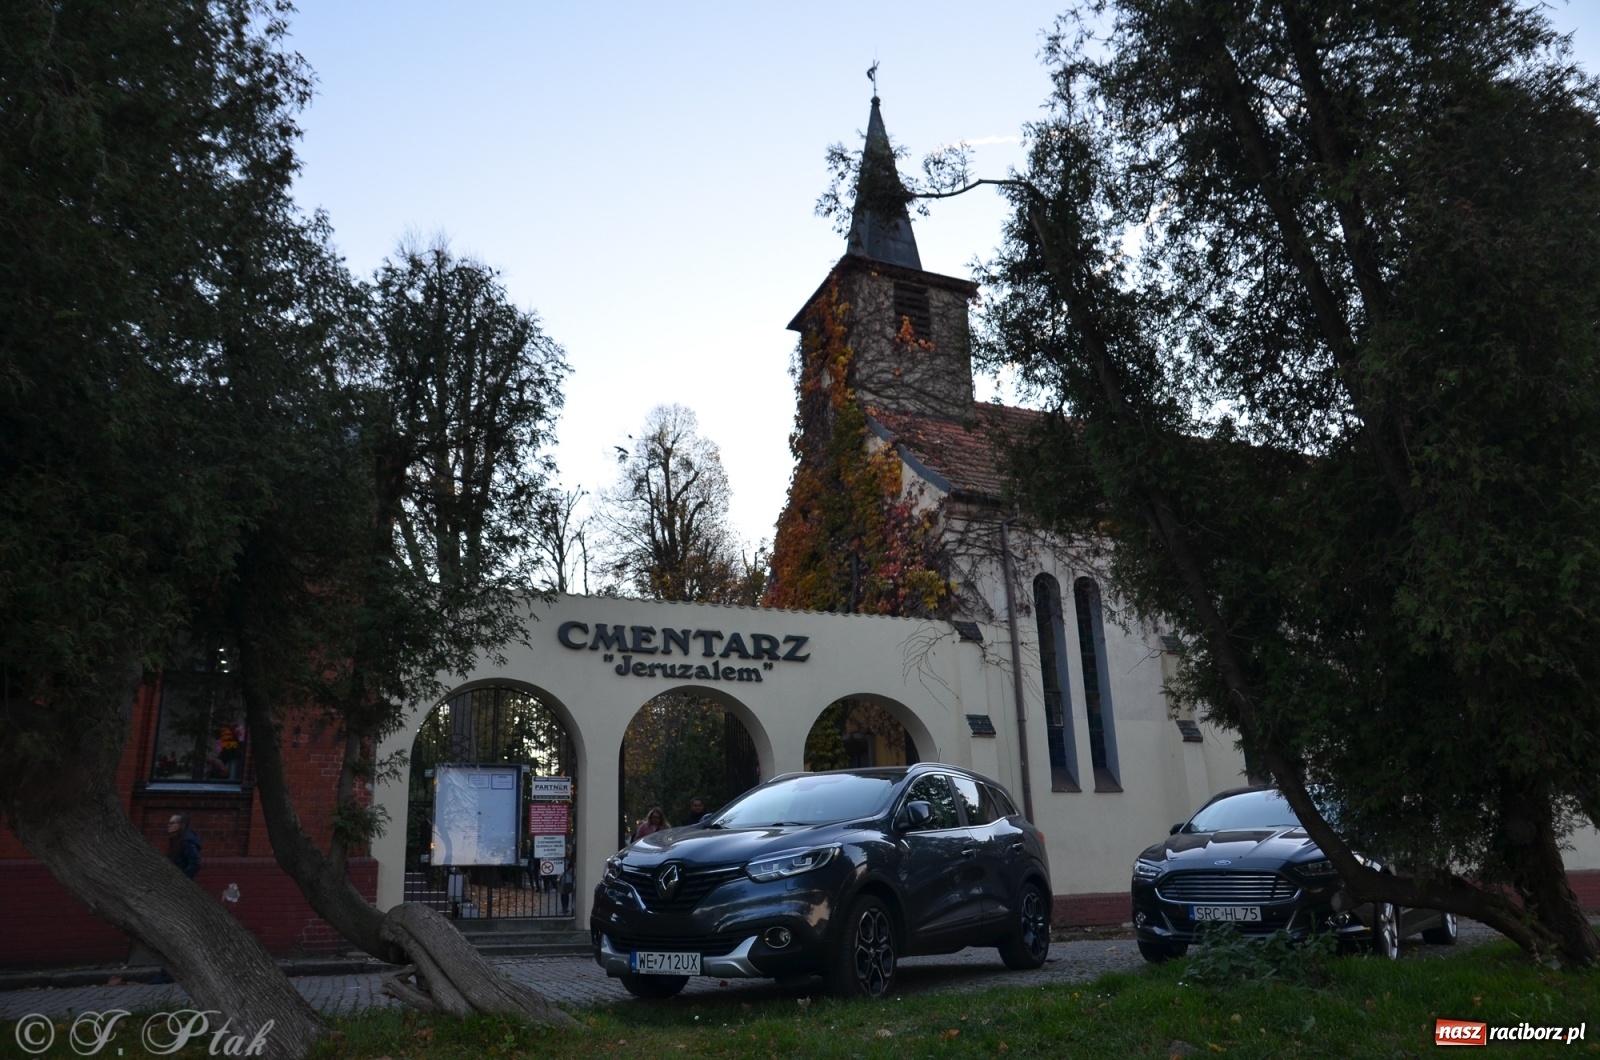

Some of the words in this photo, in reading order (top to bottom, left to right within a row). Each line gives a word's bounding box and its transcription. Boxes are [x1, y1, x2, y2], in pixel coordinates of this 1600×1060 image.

[557, 620, 811, 662] CMENTARZ
[1196, 907, 1220, 920] SRC
[1224, 907, 1258, 921] HL75
[639, 953, 654, 969] WE
[658, 954, 698, 970] 712UX
